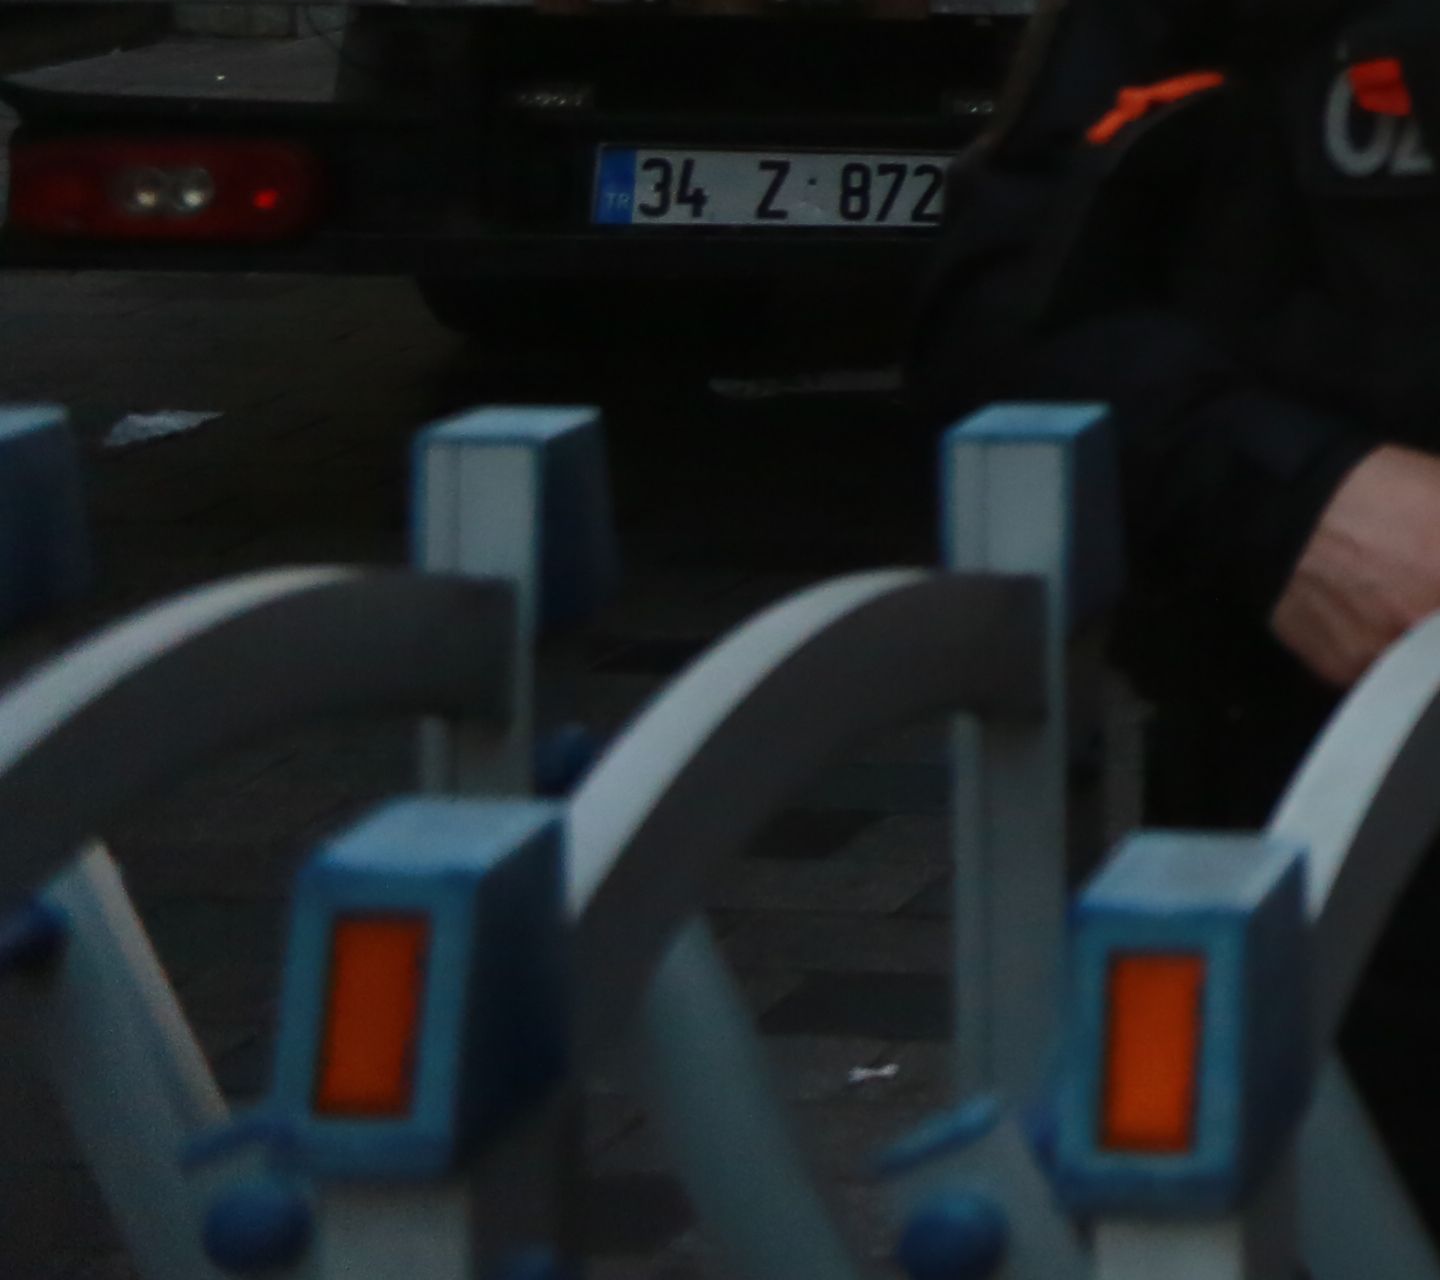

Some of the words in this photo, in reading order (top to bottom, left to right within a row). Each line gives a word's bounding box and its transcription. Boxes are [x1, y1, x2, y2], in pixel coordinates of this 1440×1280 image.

[607, 191, 631, 209] TR
[639, 158, 709, 218] 34
[756, 160, 791, 219] Z
[840, 162, 944, 223] 872
